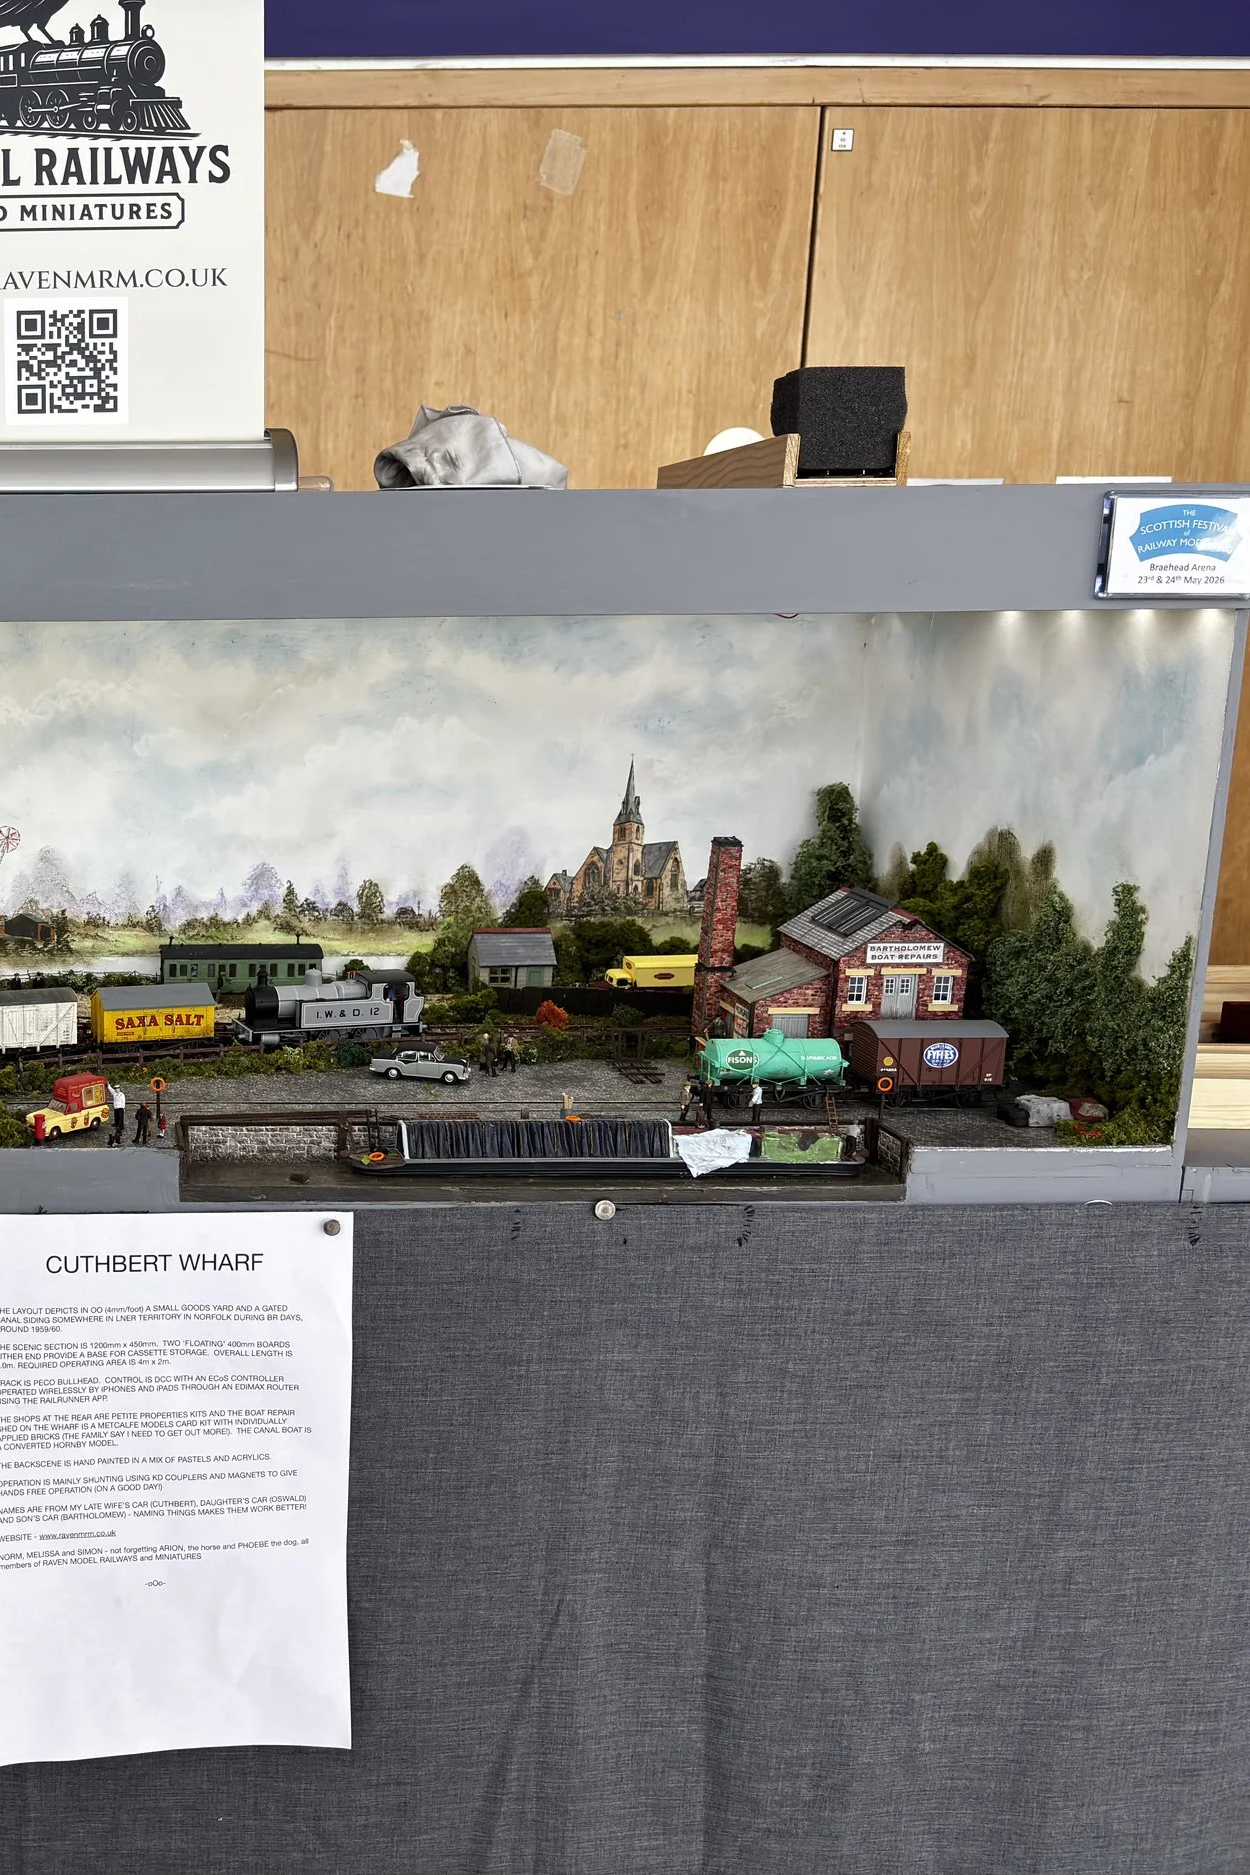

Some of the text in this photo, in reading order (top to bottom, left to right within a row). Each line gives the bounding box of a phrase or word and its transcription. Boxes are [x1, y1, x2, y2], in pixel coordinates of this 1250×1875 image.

[34, 144, 231, 186] RAILWAYS
[20, 202, 173, 222] MINIATURES
[1182, 509, 1197, 517] THE
[1140, 519, 1190, 535] SCOTTISH
[1137, 538, 1177, 554] RAILWAY
[1150, 563, 1190, 571] Braehead
[1138, 575, 1225, 585] 23rd & 24th May 2026
[339, 1009, 346, 1018] &
[370, 1007, 380, 1016] 12
[115, 1013, 204, 1030] SAXA SALT
[727, 1056, 758, 1065] FISONS
[927, 1049, 954, 1060] FYFFES
[45, 1253, 264, 1274] CUTHBERT WHARF
[12, 1307, 43, 1315] LAYOUT
[181, 1304, 211, 1312] GOODS
[262, 1304, 288, 1312] GATED
[23, 1316, 50, 1324] SIDING
[194, 1313, 232, 1321] NORFOLK
[234, 1314, 265, 1322] DURING
[24, 1379, 32, 1387] IS
[105, 1376, 143, 1384] CONTROL
[195, 1375, 206, 1383] AN
[230, 1375, 284, 1383] CONTROLLER
[38, 1387, 87, 1395] WIRELESSLY
[88, 1386, 99, 1394] BY
[137, 1385, 155, 1393] AND
[181, 1383, 220, 1391] THROUGH
[235, 1383, 265, 1391] EDIMAX
[22, 1397, 38, 1405] THE
[40, 1395, 90, 1404] RAILRUNNER
[43, 1478, 51, 1486] IS
[53, 1477, 81, 1486] MAINLY
[83, 1475, 124, 1484] SHUNTING
[125, 1474, 150, 1482] USING
[152, 1474, 163, 1482] KD
[165, 1473, 208, 1482] COUPLERS
[209, 1472, 226, 1480] AND
[228, 1471, 266, 1479] MAGNETS
[267, 1470, 278, 1478] TO
[280, 1469, 297, 1477] GIVE
[48, 1486, 92, 1495] OPERATION
[94, 1485, 108, 1494] (ON
[109, 1485, 116, 1493] A
[117, 1484, 141, 1492] GOOD
[26, 1550, 60, 1559] MELISSA
[61, 1550, 75, 1558] and
[77, 1548, 103, 1556] SIMON
[110, 1547, 122, 1555] not
[123, 1546, 157, 1556] forgetting
[200, 1542, 221, 1551] horse
[222, 1542, 236, 1550] and
[238, 1540, 269, 1549] PHOEBE
[270, 1539, 282, 1547] the
[301, 1538, 309, 1546] all
[33, 1560, 41, 1568] of
[42, 1558, 68, 1567] RAVEN
[70, 1557, 98, 1565] MODEL
[99, 1555, 138, 1564] RAILWAYS
[139, 1555, 153, 1563] and
[155, 1552, 202, 1562] MINIATURES
